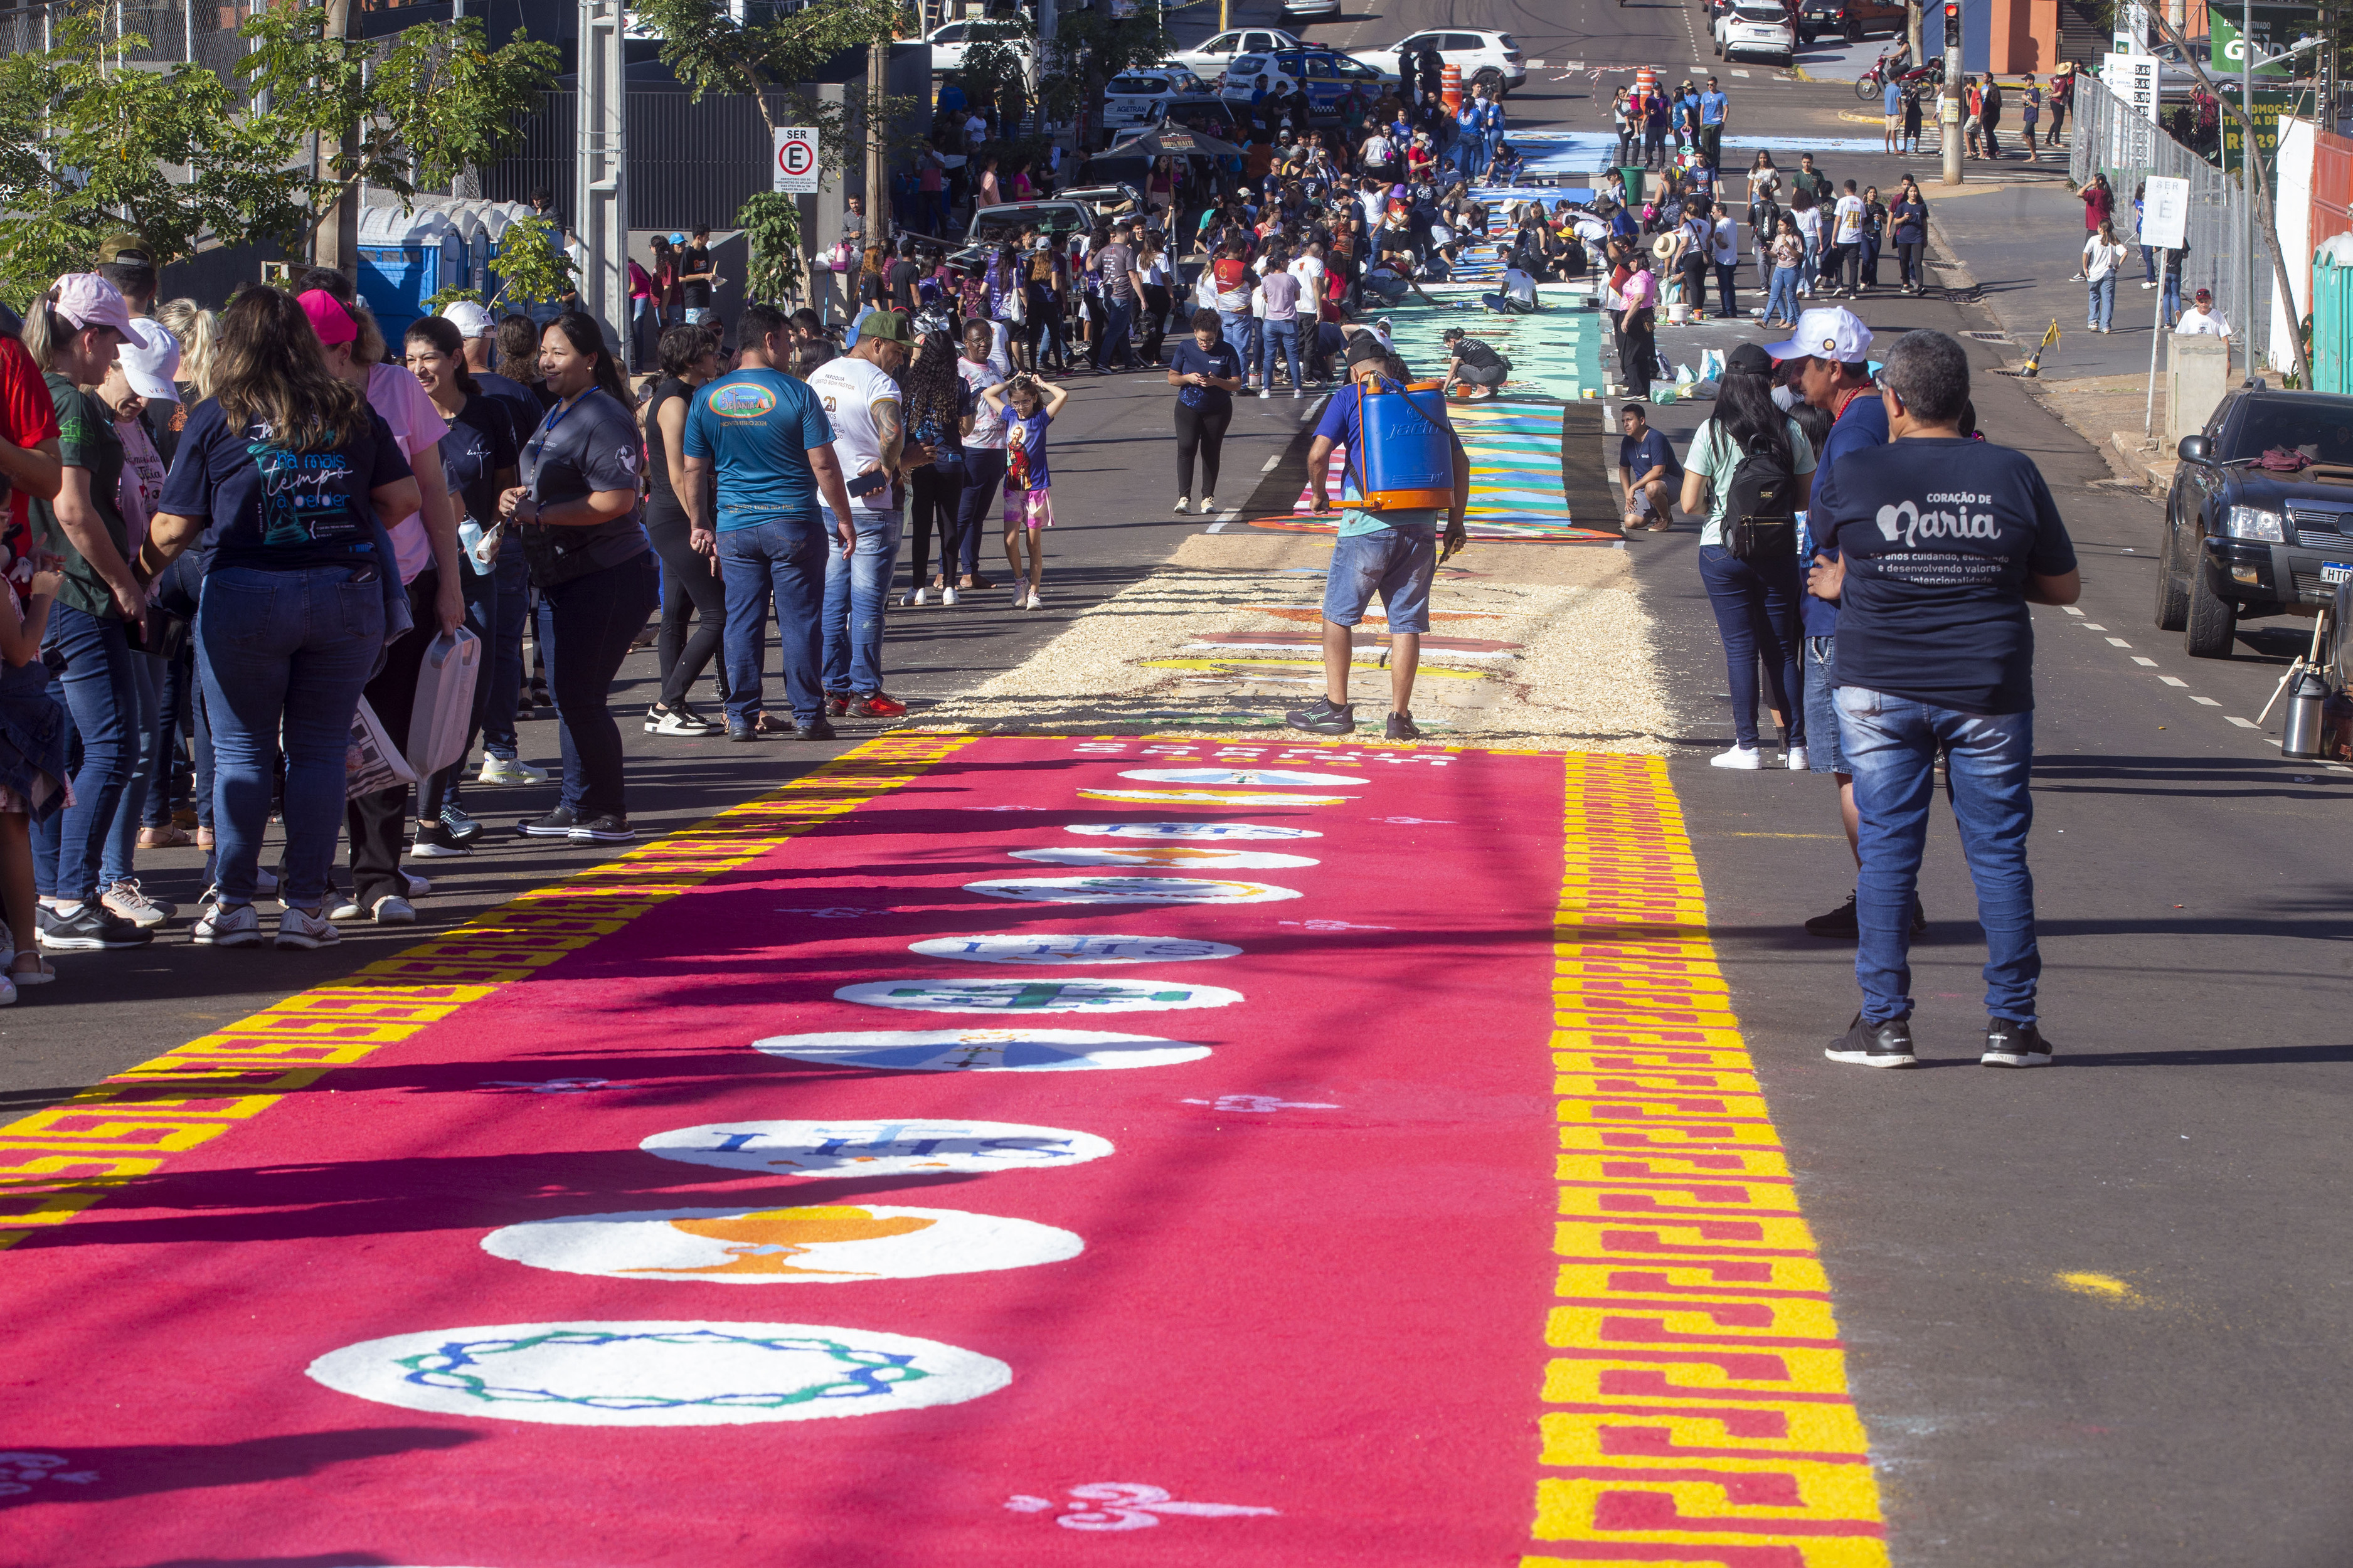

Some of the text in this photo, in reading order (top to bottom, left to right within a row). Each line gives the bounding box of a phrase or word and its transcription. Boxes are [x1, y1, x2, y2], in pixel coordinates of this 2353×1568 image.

[2135, 66, 2150, 74] 3,69
[2135, 80, 2149, 88] 5,69
[2134, 93, 2150, 102] 5,99
[2235, 102, 2298, 114] POMOÇÃO
[2223, 115, 2279, 125] TRA DE
[787, 130, 807, 139] SER
[2256, 134, 2277, 148] 29
[789, 147, 803, 168] E
[2156, 181, 2179, 190] SER
[2159, 199, 2172, 219] E
[838, 382, 855, 391] PASTOR
[824, 396, 837, 413] 20
[1386, 420, 1439, 441] jacto
[277, 450, 346, 469] há mais
[264, 459, 353, 504] tempo
[294, 491, 351, 512] perder
[1926, 491, 1992, 505] CORAÇÃO DE
[1876, 500, 2002, 548] Maria
[1912, 553, 1960, 562] cuidando,
[1962, 553, 2009, 564] edundo
[1886, 564, 1962, 573] desenvolvendo
[1965, 563, 2002, 573] valores
[1910, 576, 1994, 585] intencionalidade.
[1072, 748, 1448, 766] CHRISTI
[1078, 743, 1458, 761] CORPUS
[1162, 756, 1364, 767] 2025
